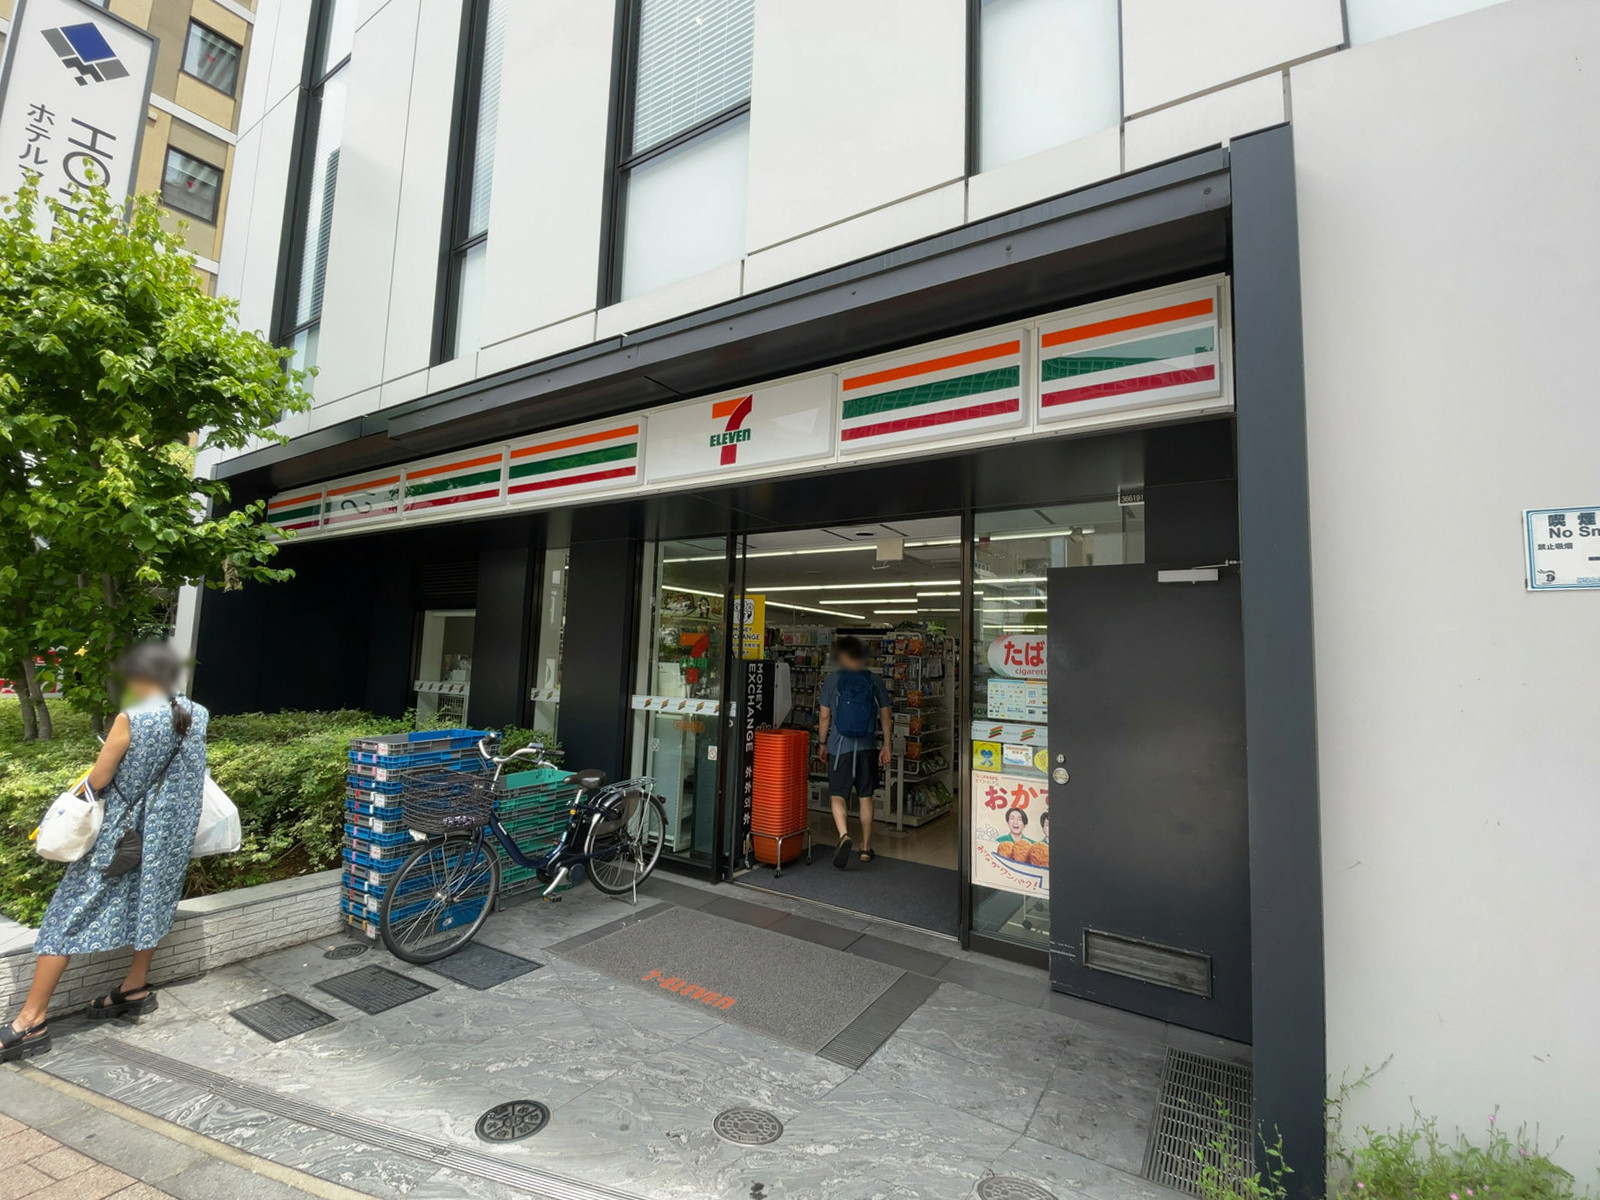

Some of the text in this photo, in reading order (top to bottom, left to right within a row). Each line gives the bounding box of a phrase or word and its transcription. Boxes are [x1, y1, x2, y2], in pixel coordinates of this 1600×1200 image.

[712, 394, 753, 466] 7
[1549, 528, 1573, 538] No
[745, 663, 756, 752] EXCHANGE
[755, 663, 763, 711] MONEY
